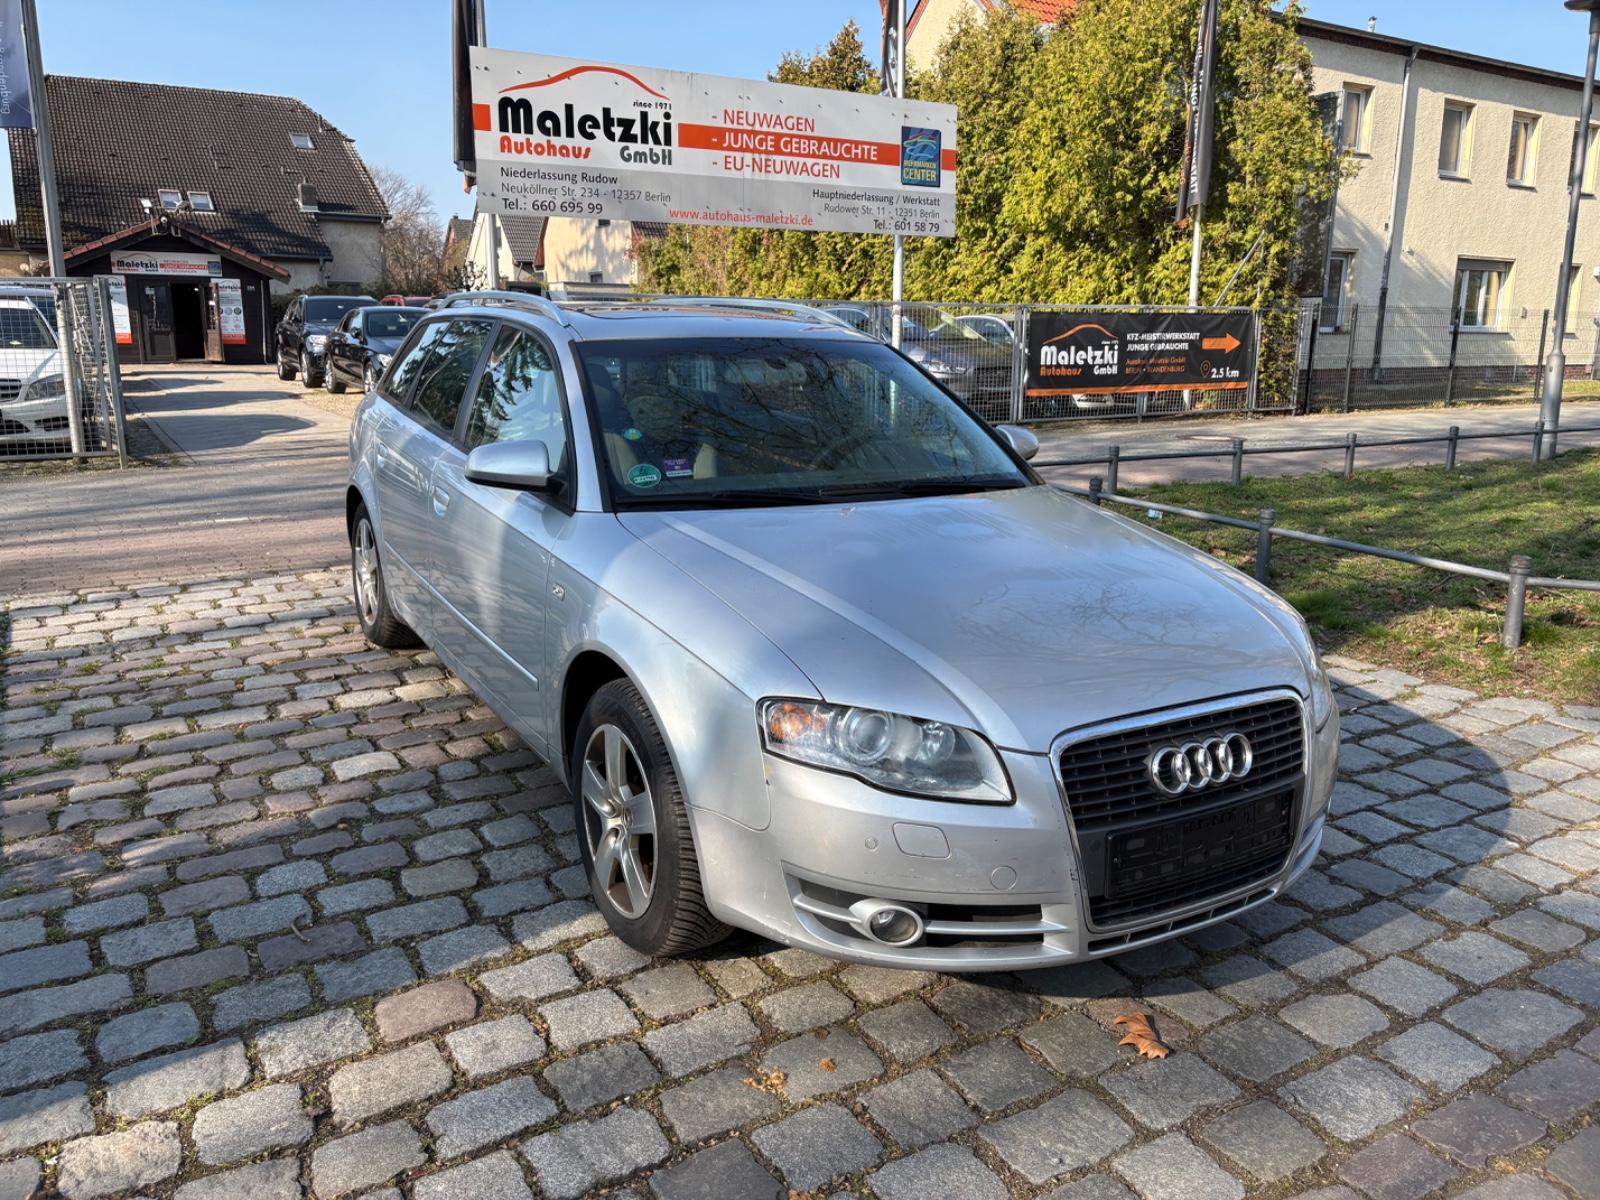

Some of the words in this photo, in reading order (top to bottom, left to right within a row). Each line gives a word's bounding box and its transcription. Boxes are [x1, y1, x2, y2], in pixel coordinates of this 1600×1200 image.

[633, 100, 652, 108] since
[655, 102, 672, 110] 1971
[498, 96, 672, 147] Maletzki
[723, 109, 815, 133] NEUWAGEN
[500, 135, 593, 160] Autohaus
[619, 145, 672, 166] GmbH
[722, 131, 775, 151] JUNGE
[780, 137, 878, 160] GEBRAUCHTE
[724, 155, 840, 179] EU-NEUWAGEN
[904, 168, 937, 182] CENTER
[500, 167, 578, 184] Niederlassung
[581, 172, 618, 185] Rudow
[501, 182, 558, 196] Neuköllner
[561, 186, 577, 197] Str.
[580, 187, 600, 198] 234
[611, 189, 642, 200] 12357
[645, 191, 671, 203] Berlin
[812, 188, 894, 206] Hauptniederlassung
[902, 195, 940, 207] Werkstatt
[502, 198, 527, 210] Tel.:
[531, 200, 556, 212] 660
[559, 201, 584, 214] 695
[587, 202, 603, 215] 99
[824, 203, 859, 214] Rudower
[861, 205, 874, 215] Str.
[877, 206, 885, 216] 11
[895, 208, 918, 217] 12351
[919, 209, 940, 219] Berlin
[669, 209, 814, 226] www.autohaus-maletzki.de
[873, 219, 892, 231] Tel.:
[894, 220, 911, 232] 601
[914, 222, 926, 232] 58
[928, 222, 940, 233] 79
[1040, 344, 1119, 365] Maletzki
[1126, 343, 1150, 352] JUNGE
[1040, 366, 1082, 377] Autohaus
[1093, 364, 1118, 375] GmbH
[1226, 366, 1239, 378] km
